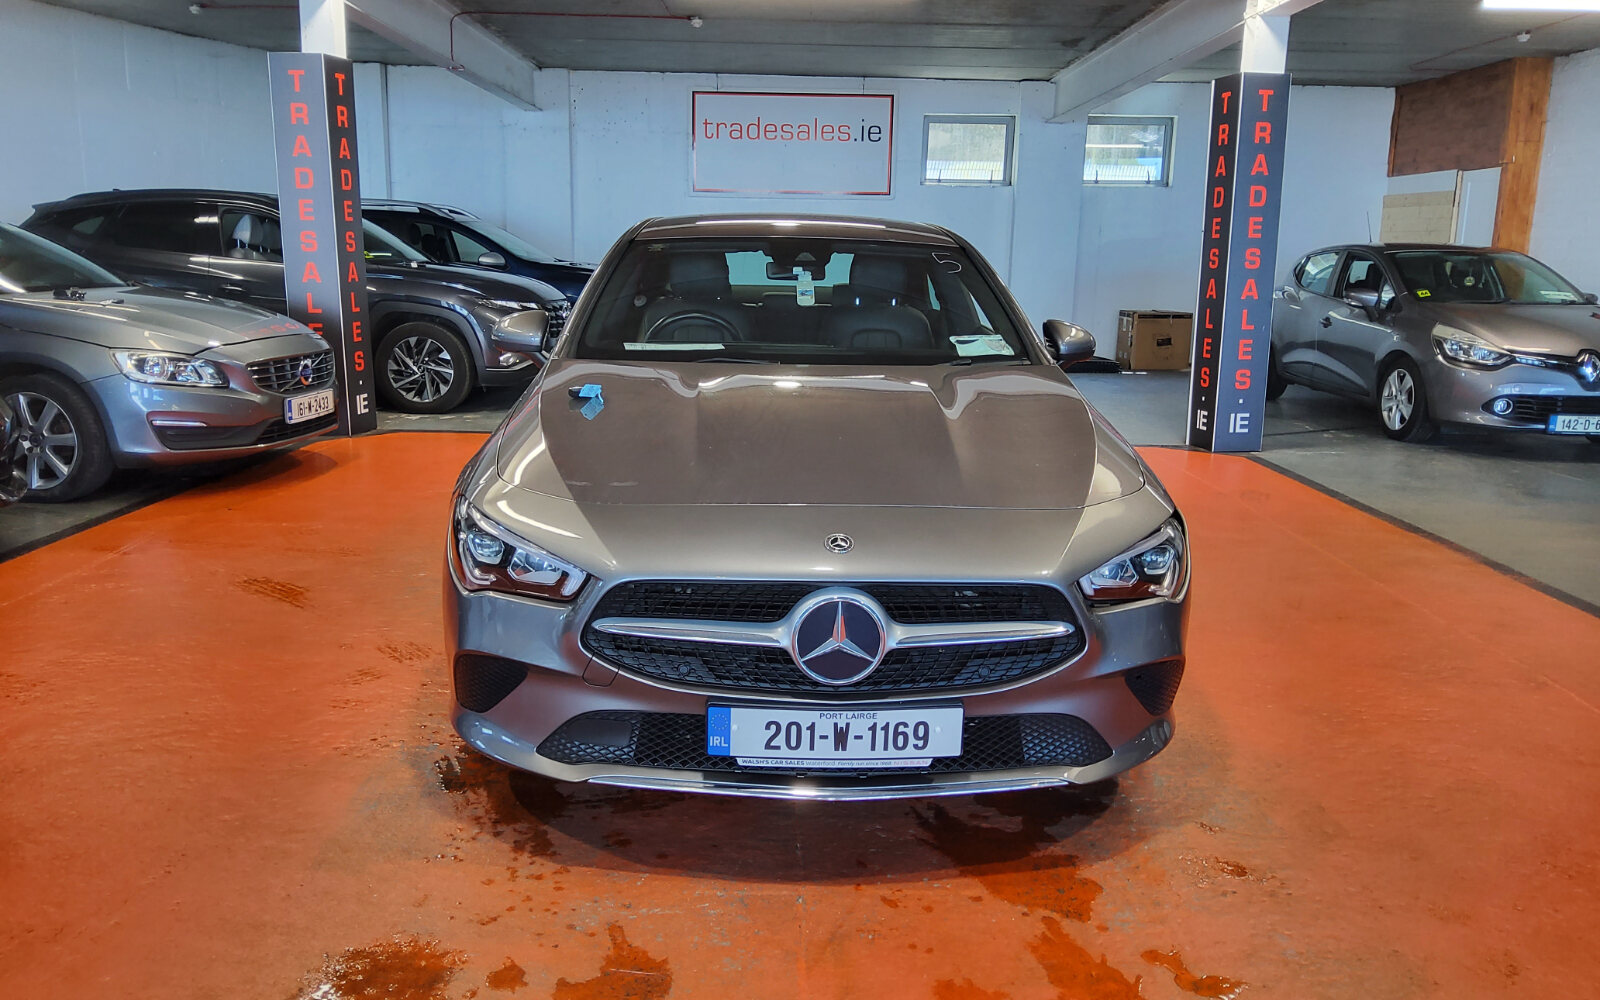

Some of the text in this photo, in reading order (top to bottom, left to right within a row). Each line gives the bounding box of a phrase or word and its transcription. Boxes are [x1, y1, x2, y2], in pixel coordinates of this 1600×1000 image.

[702, 116, 883, 143] tradesales.ie
[931, 252, 962, 274] 5
[297, 396, 329, 417] 161-W-2433
[819, 712, 843, 720] PORT
[709, 735, 729, 748] IRL
[764, 720, 930, 752] 201-W-1169
